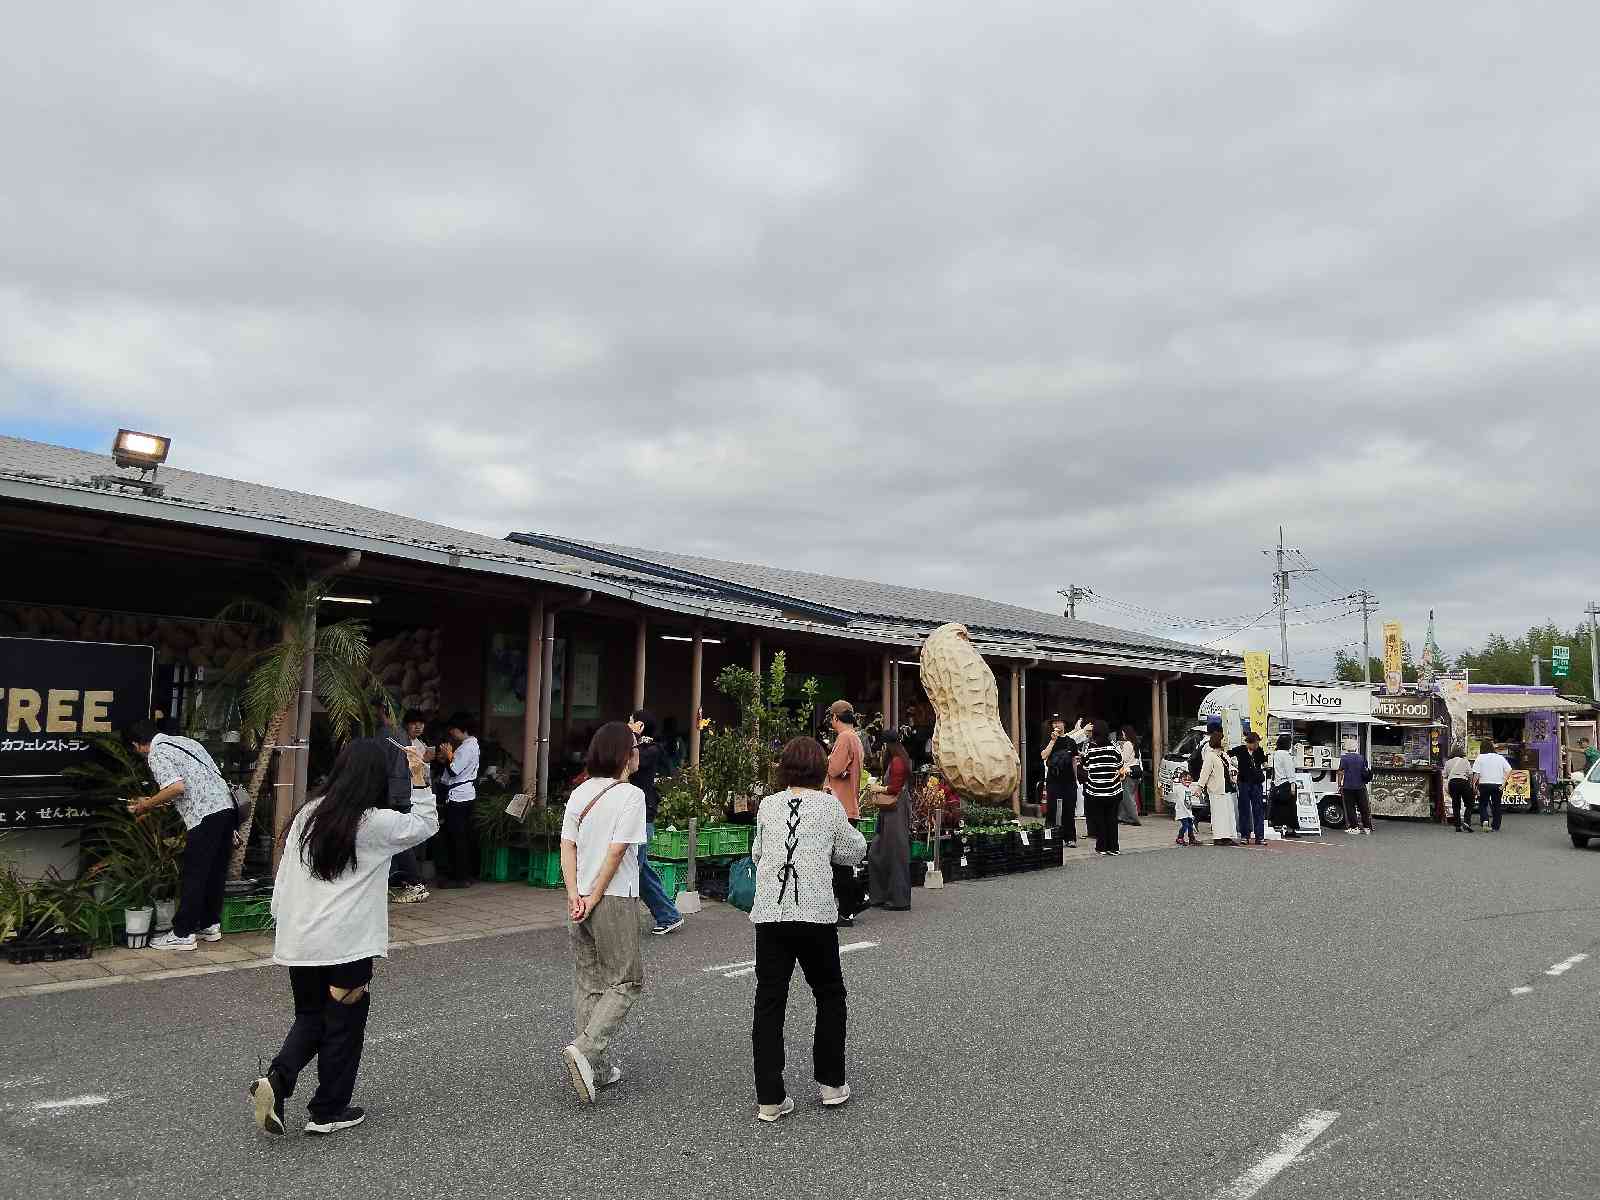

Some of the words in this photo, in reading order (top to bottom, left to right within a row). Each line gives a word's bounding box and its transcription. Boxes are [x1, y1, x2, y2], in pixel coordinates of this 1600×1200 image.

[1310, 693, 1342, 705] Nora
[0, 688, 114, 733] REE
[1402, 704, 1428, 715] FOOD
[1, 739, 90, 751] カフェレストラン
